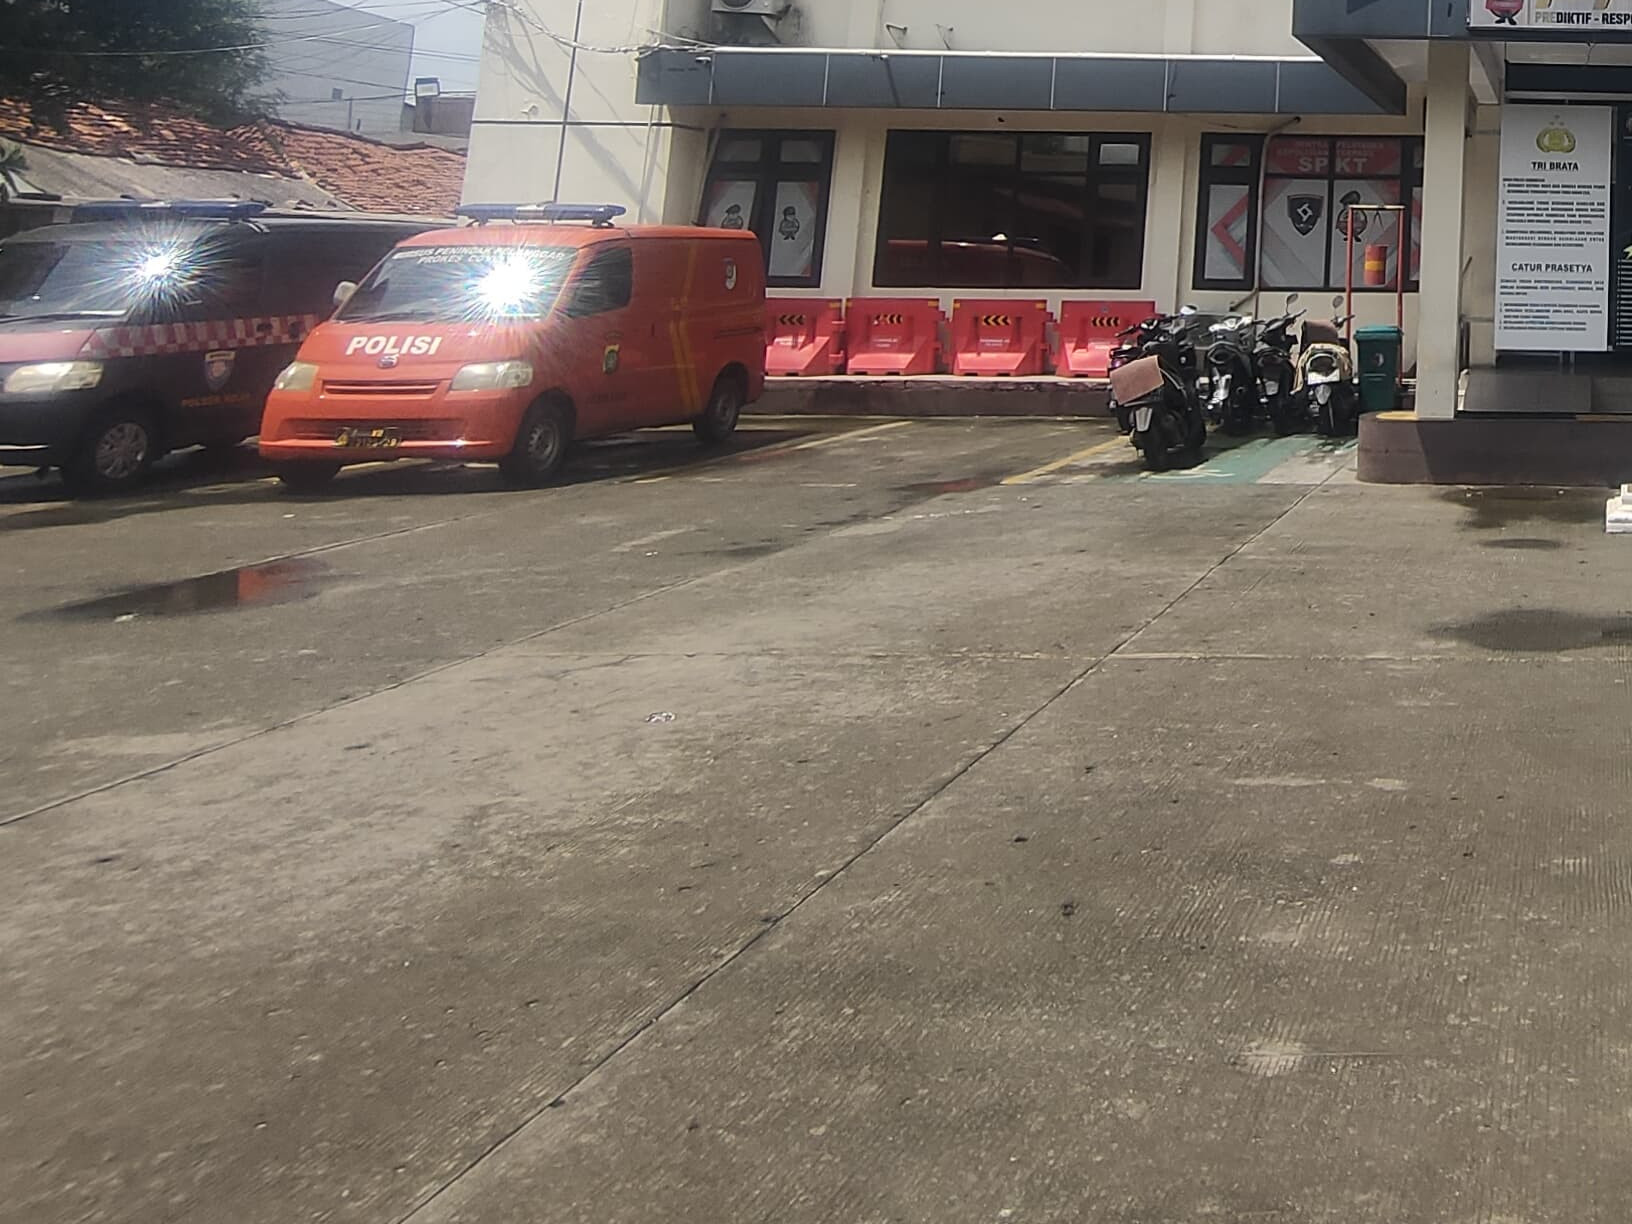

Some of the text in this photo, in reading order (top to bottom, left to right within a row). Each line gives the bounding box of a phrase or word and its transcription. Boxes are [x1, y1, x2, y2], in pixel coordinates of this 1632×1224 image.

[1531, 161, 1579, 171] TRI BRATA
[1511, 263, 1593, 273] CATUR PRASETYA
[345, 336, 443, 356] POLISI
